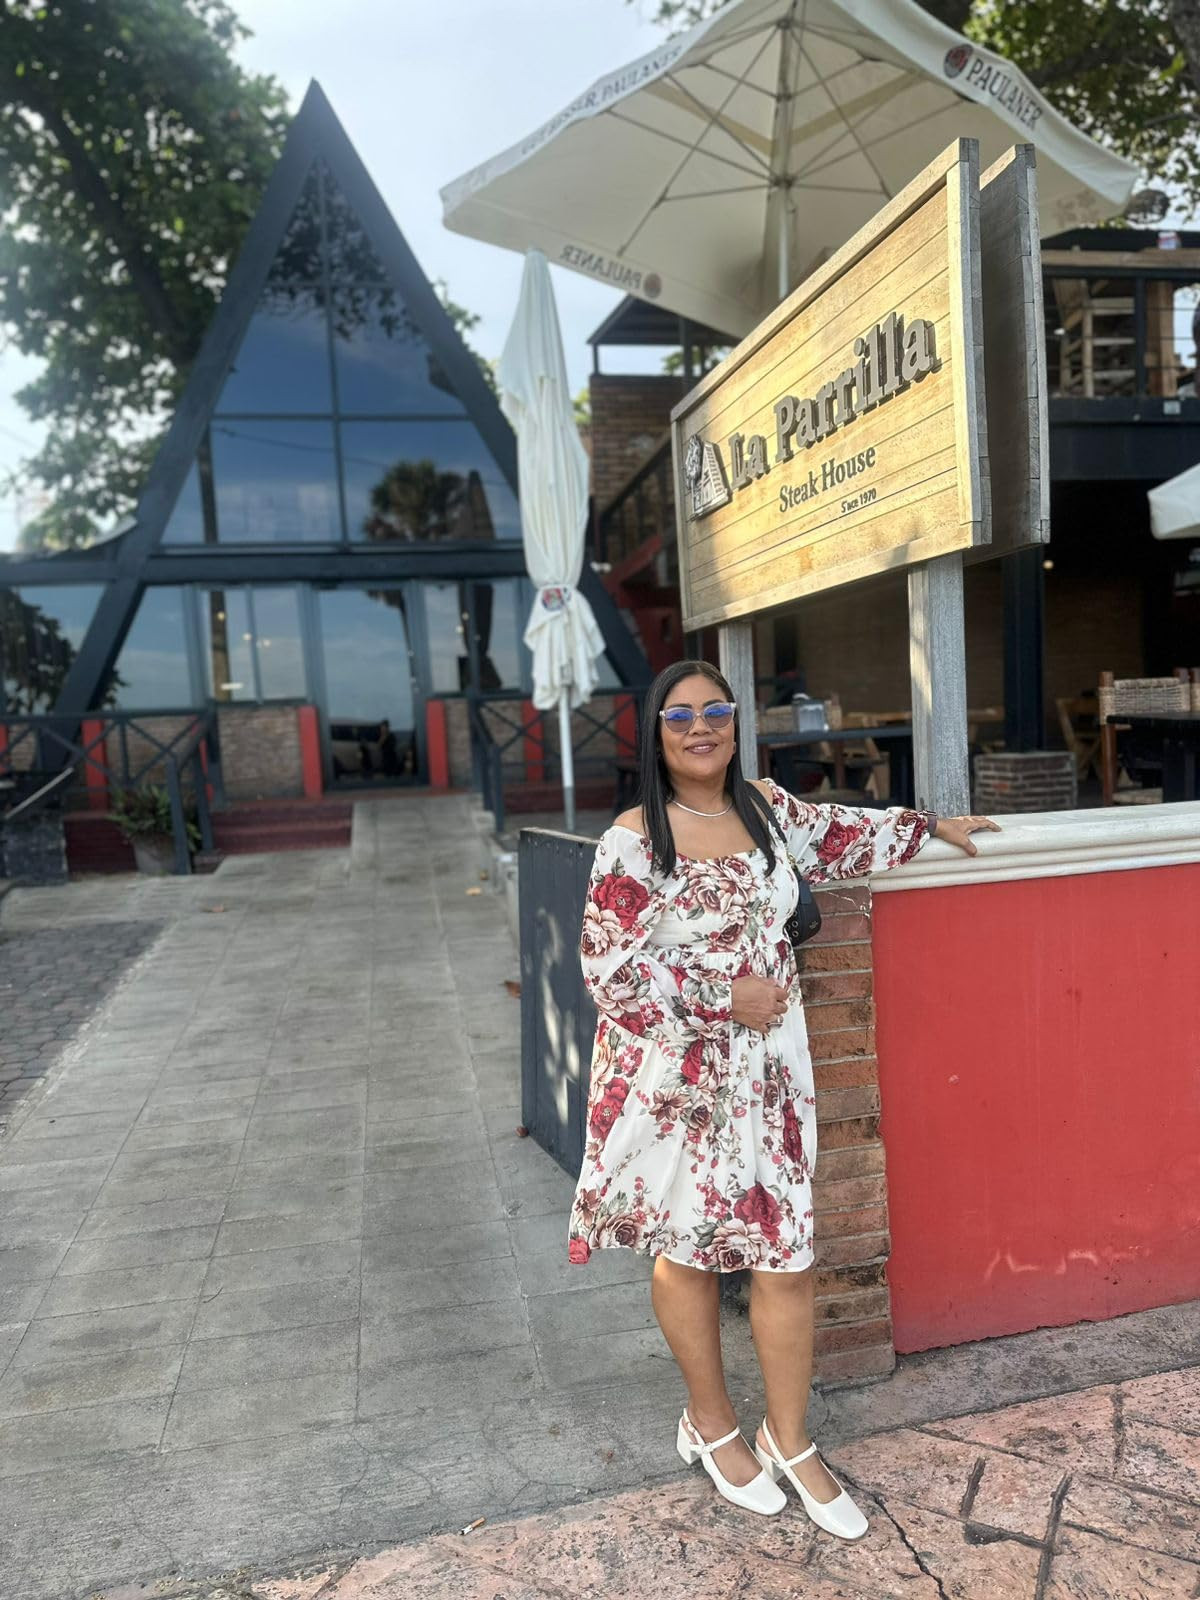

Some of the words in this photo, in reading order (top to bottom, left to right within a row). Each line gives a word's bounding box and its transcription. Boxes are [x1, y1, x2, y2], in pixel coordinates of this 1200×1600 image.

[965, 57, 1043, 131] PAULANER
[728, 431, 770, 490] La
[774, 311, 940, 464] Parrilla
[779, 470, 820, 514] Steak
[821, 446, 876, 492] House
[859, 487, 877, 506] 1970
